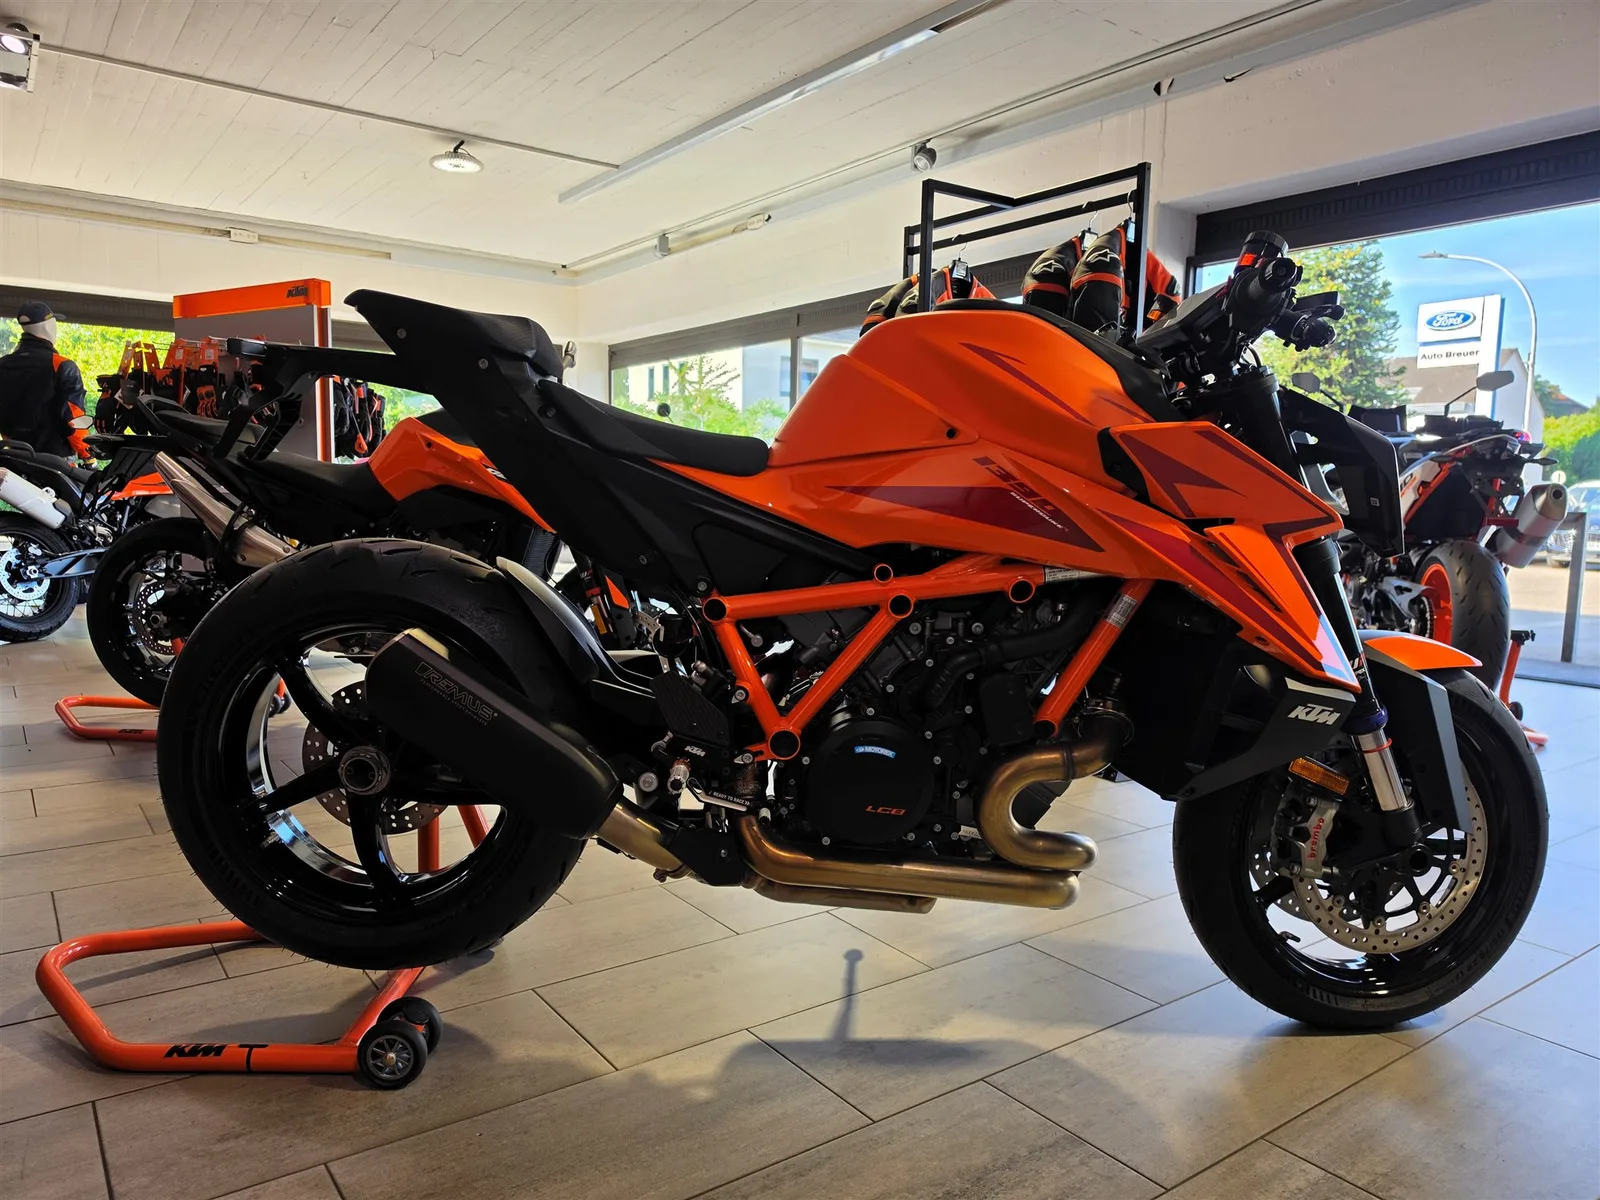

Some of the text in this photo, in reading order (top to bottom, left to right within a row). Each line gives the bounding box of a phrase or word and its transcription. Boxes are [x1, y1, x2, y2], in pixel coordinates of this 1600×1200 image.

[286, 285, 309, 298] KTM
[1432, 312, 1466, 328] Ford
[1420, 349, 1480, 361] Auto Breuer
[423, 669, 494, 721] REMUS
[1287, 703, 1341, 726] KTM
[684, 745, 706, 757] KTM
[864, 746, 895, 758] MOTOREX
[713, 791, 728, 800] READY
[733, 797, 745, 805] RACE
[1308, 817, 1324, 860] brembo
[164, 1043, 228, 1058] KTM
